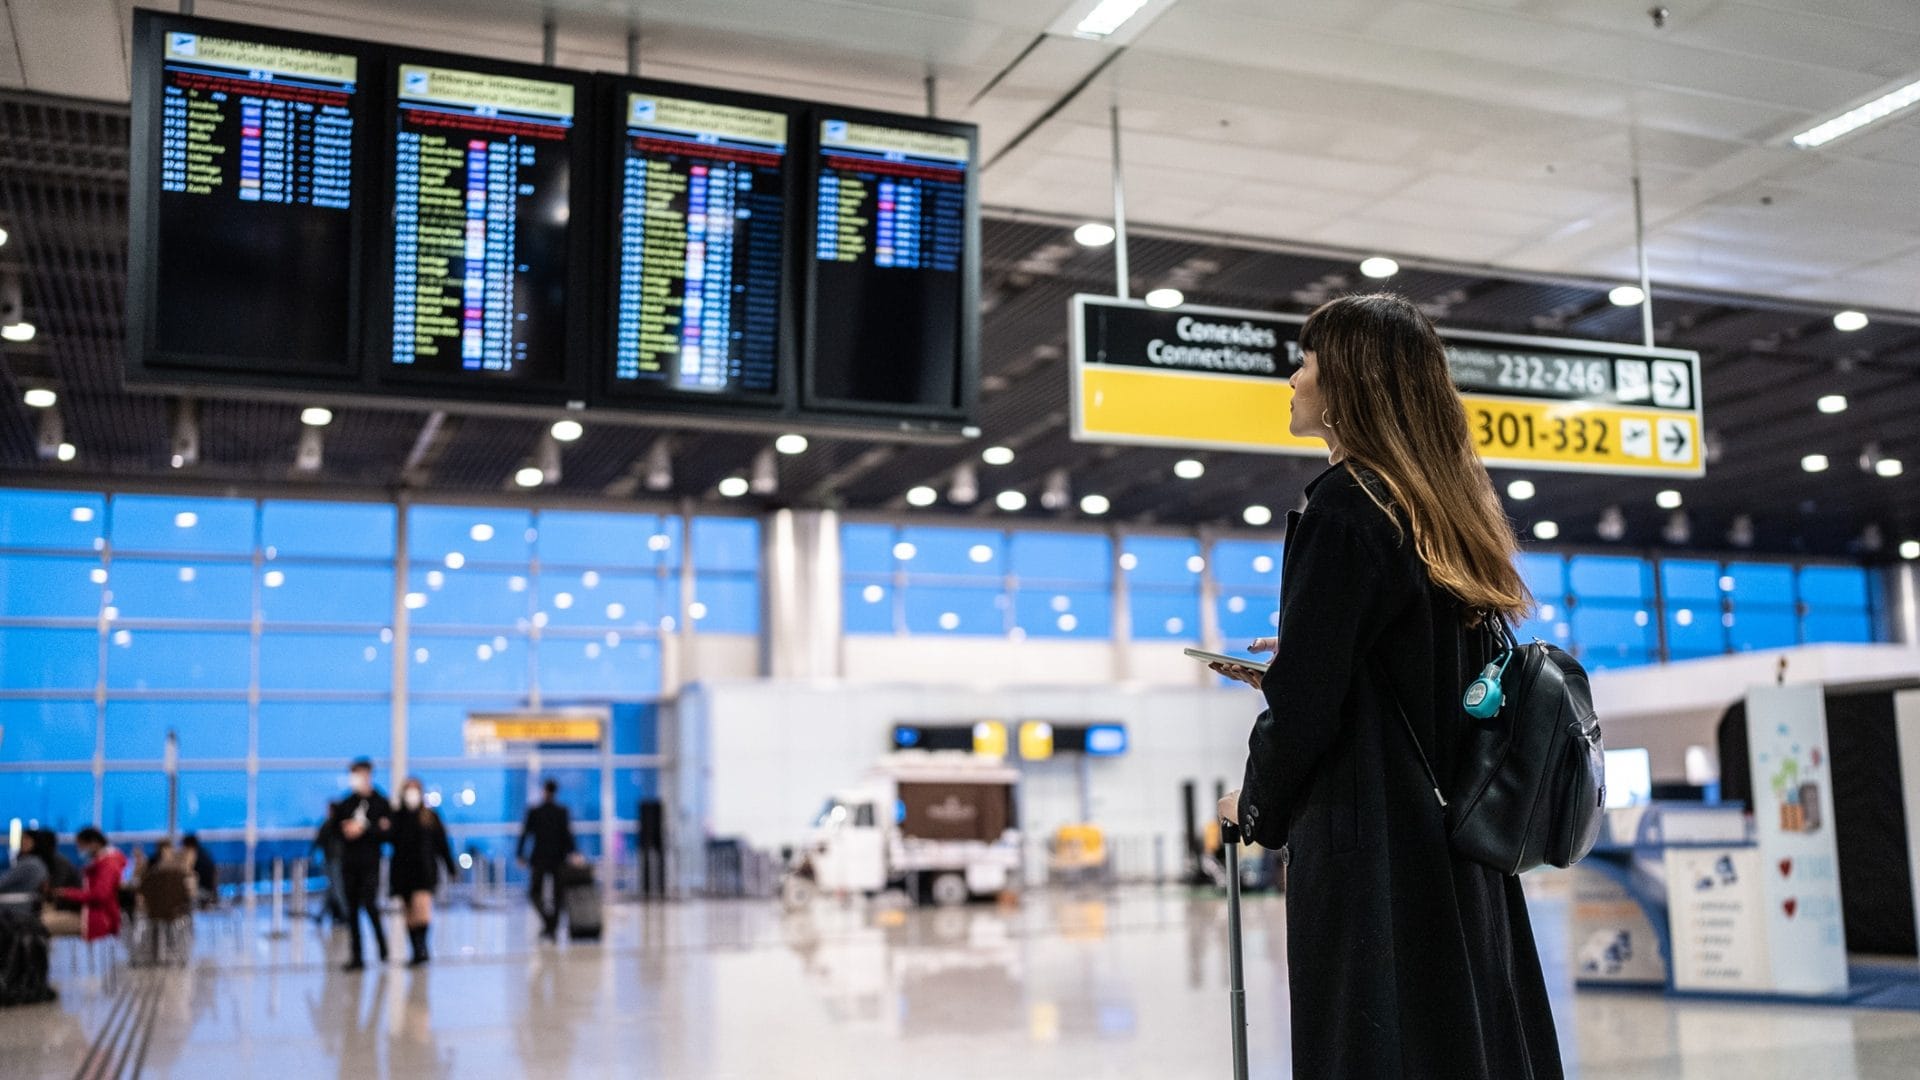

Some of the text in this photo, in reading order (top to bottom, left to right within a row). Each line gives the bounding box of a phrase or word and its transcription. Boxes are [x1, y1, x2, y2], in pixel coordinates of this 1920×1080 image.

[1176, 316, 1277, 348] Conexões
[1147, 339, 1276, 373] Connections
[1496, 354, 1606, 395] 232-246
[1477, 410, 1609, 454] 301-332
